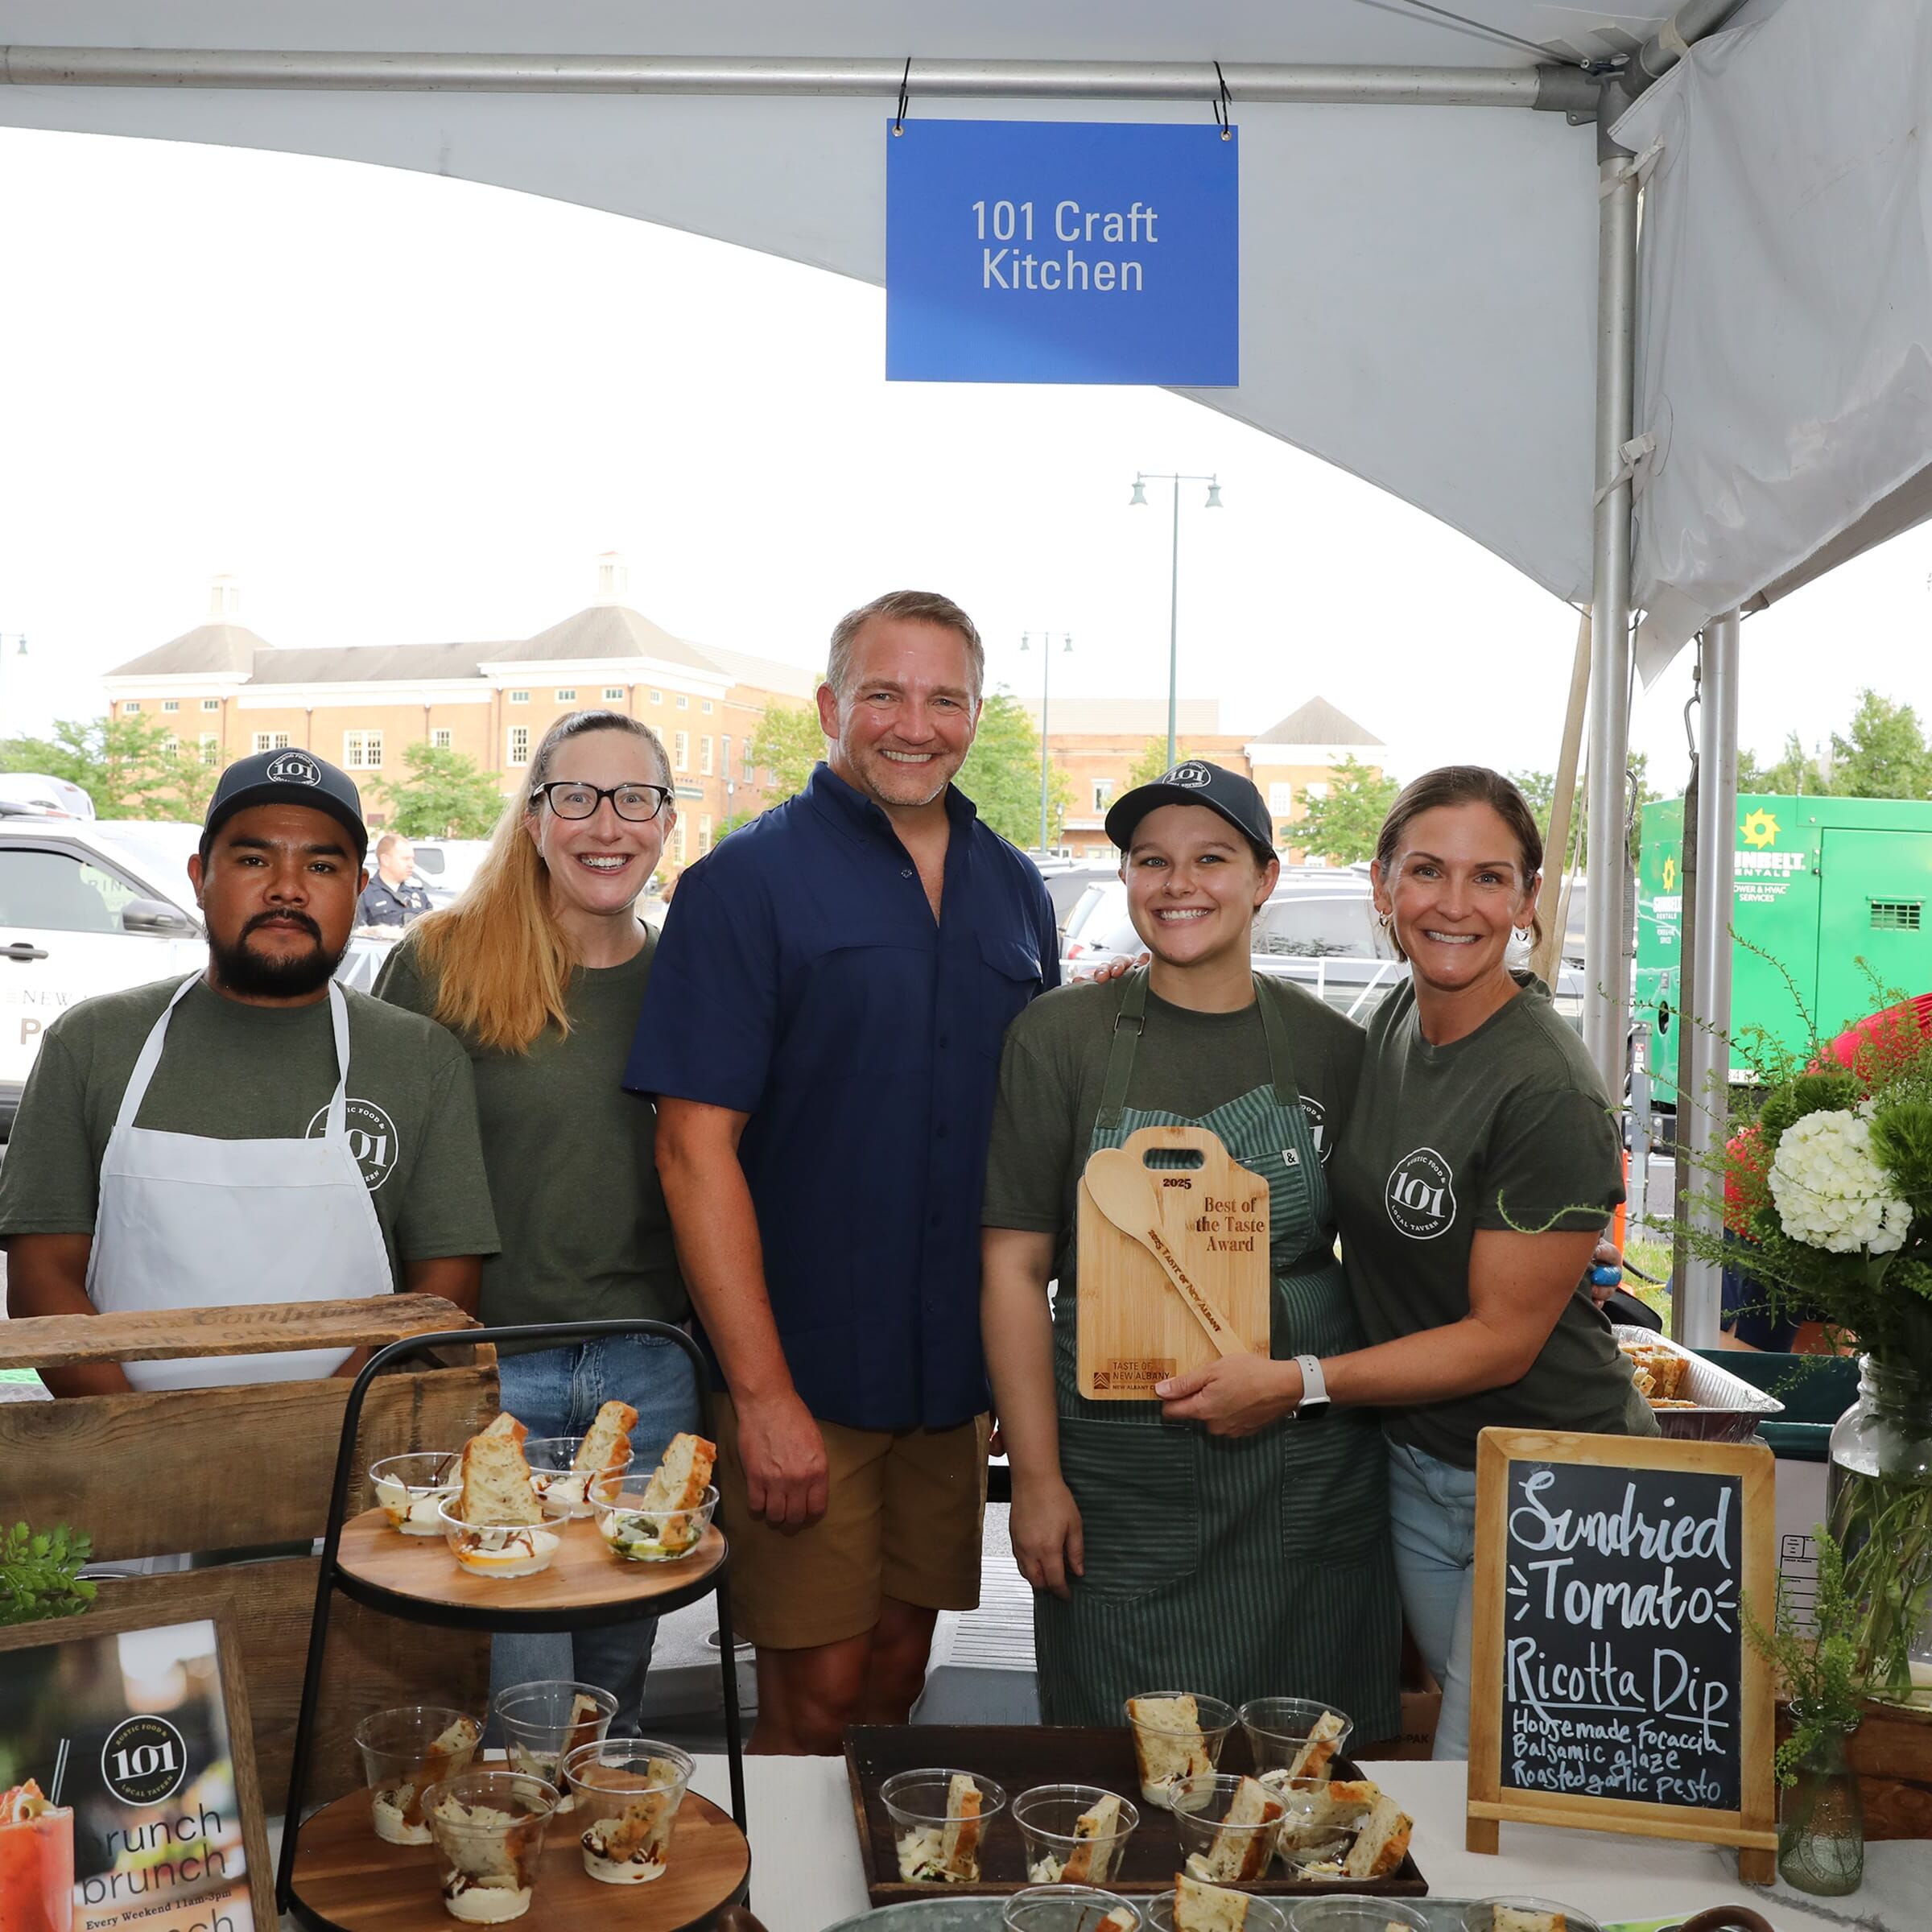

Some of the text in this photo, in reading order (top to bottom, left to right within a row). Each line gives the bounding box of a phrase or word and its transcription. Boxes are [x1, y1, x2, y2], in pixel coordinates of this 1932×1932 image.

[972, 200, 1158, 242] 101 Craft
[983, 248, 1142, 291] Kitchen
[273, 763, 316, 781] 101
[1166, 770, 1205, 782] 101
[1734, 851, 1805, 870] NBELT
[1734, 869, 1790, 877] ENTALS
[1733, 886, 1756, 894] OWER
[1739, 894, 1775, 902] SERVICES
[1301, 1104, 1317, 1115] OOD
[332, 1129, 386, 1167] 01
[1427, 1160, 1443, 1177] FOOD
[1162, 1178, 1192, 1190] 2025
[1390, 1172, 1446, 1218] 101
[1204, 1197, 1257, 1212] Best of
[1195, 1216, 1265, 1232] the Taste
[1392, 1205, 1439, 1231] LOCAL TAVERN
[1206, 1236, 1255, 1252] Award
[1113, 1362, 1153, 1370] TASTE OF
[1113, 1372, 1170, 1381] NEW ALBANY
[1509, 1470, 1732, 1569] Sundried
[1528, 1557, 1714, 1630] Tomato
[1507, 1637, 1729, 1740] Ricotta Dip
[115, 1725, 141, 1746] RUSTIC
[141, 1724, 162, 1733] FOOD
[112, 1740, 180, 1781] 101
[1512, 1733, 1682, 1774] Balsamic glaze
[122, 1774, 174, 1798] LOCAL TAVERN
[1656, 1768, 1722, 1802] pesto
[81, 1843, 226, 1905] brunch
[86, 1916, 119, 1930] Every
[122, 1901, 171, 1921] Weekend
[175, 1890, 233, 1909] 11am-3pm
